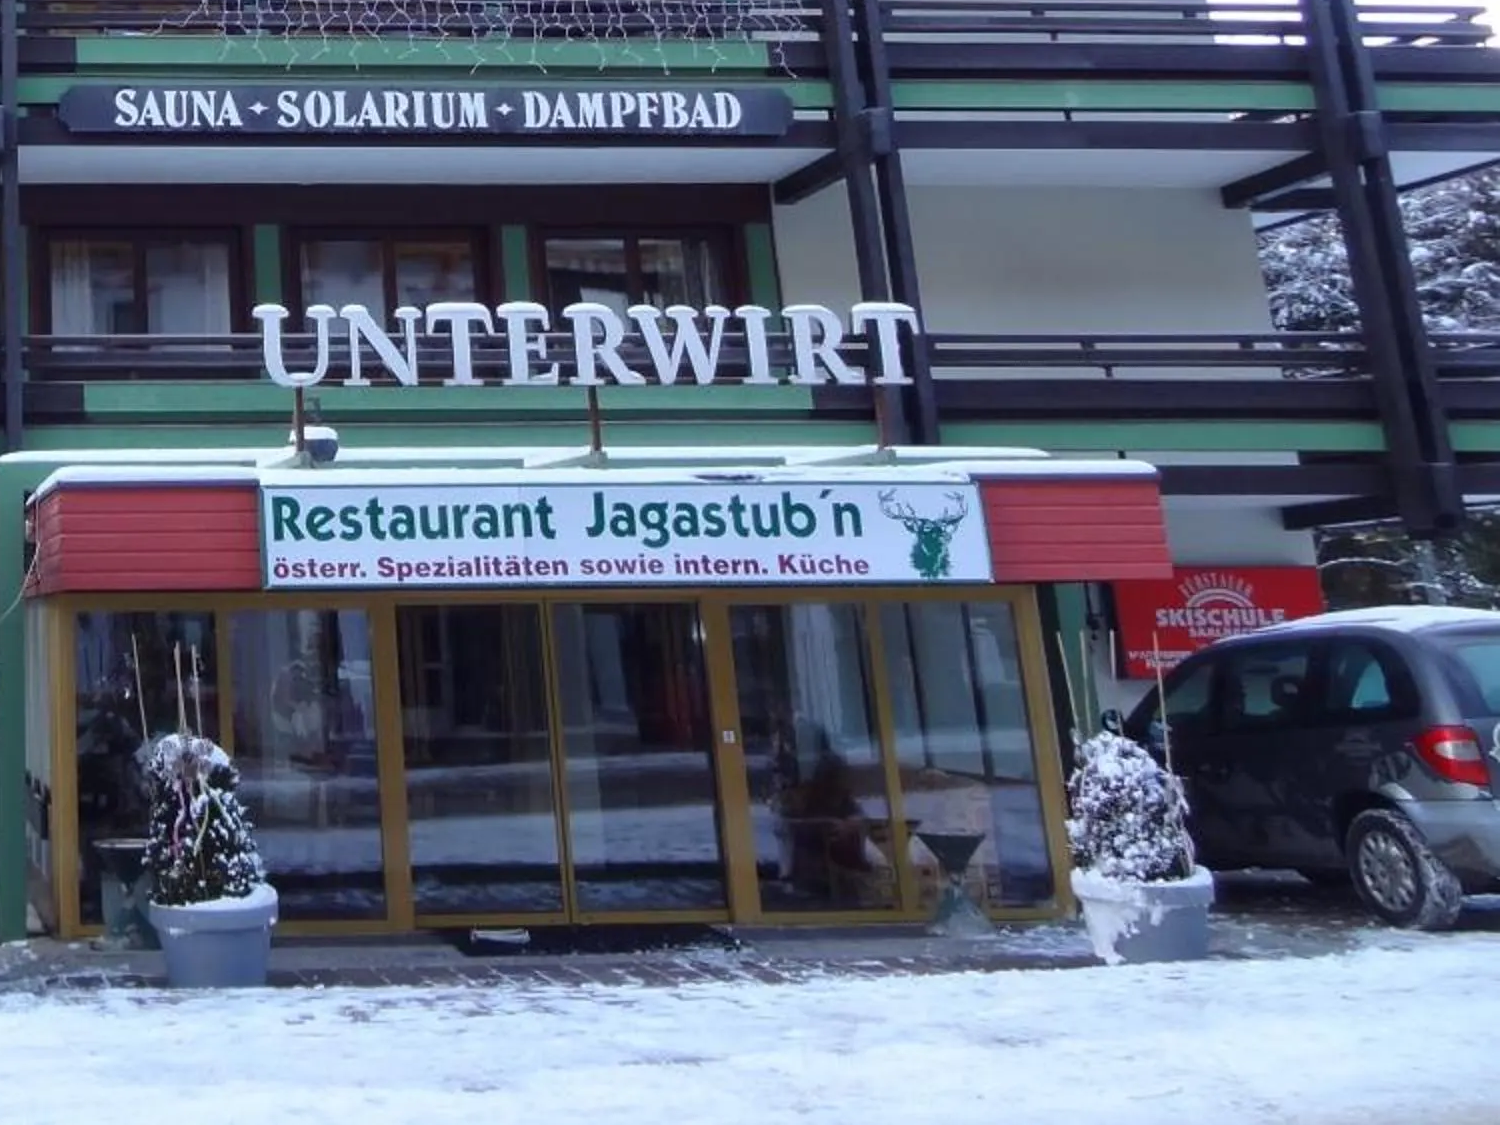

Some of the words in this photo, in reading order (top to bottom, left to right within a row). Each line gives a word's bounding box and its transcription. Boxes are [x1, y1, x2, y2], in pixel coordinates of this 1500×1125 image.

[114, 88, 244, 128] SAUNA
[276, 89, 489, 129] SOLARIUM
[521, 90, 742, 129] DAMPFBAD
[252, 302, 920, 387] UNTERWIRT
[271, 495, 557, 542] Restaurant
[273, 556, 367, 579] österr.
[377, 555, 570, 582] Spezialitäten
[579, 554, 665, 576] sowie
[674, 554, 769, 576] intern.
[777, 553, 870, 576] Küche
[1155, 608, 1285, 628] SKISCHULE
